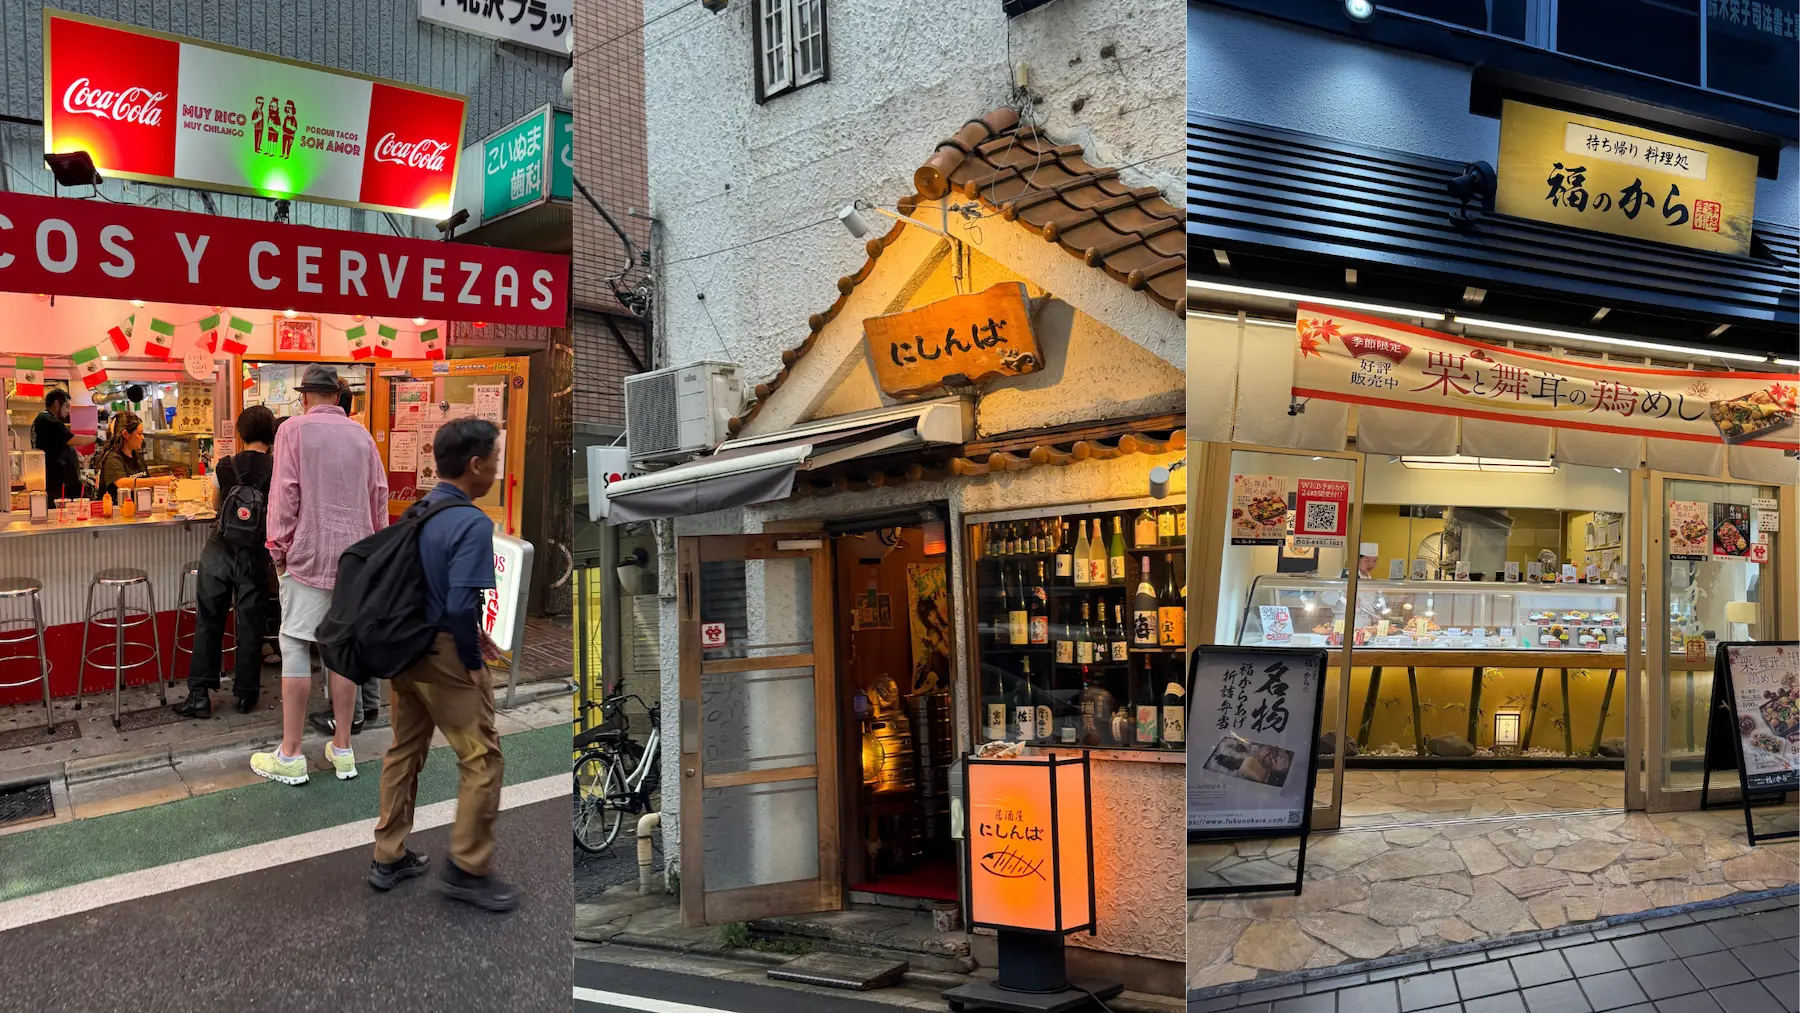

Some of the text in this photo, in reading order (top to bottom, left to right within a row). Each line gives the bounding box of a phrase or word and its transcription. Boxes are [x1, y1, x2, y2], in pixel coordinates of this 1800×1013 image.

[63, 77, 169, 126] Coca-Cola
[182, 104, 247, 126] MUY RICO
[183, 120, 244, 137] MUY CHILANGO
[300, 136, 361, 156] SON AMOR
[305, 125, 358, 141] PORQUE TACOS
[374, 132, 451, 172] Coca-Cola
[487, 125, 541, 175] こいぬま
[1586, 134, 1689, 170] 持ち帰り 料理処
[511, 160, 540, 200] 歯科
[1546, 162, 1689, 226] 福のから
[174, 232, 210, 284] Y
[248, 241, 554, 311] CERVEZAS
[891, 317, 1008, 367] にしんば
[1351, 335, 1402, 353] 季節限定
[1350, 372, 1399, 390] 販売中
[1360, 359, 1392, 375] 好評
[1409, 348, 1706, 421] 栗と舞茸の鶏めし
[1216, 669, 1238, 730] 折詰弁当
[1233, 662, 1254, 729] 福からあげ
[1251, 660, 1289, 734] 名物
[980, 823, 1044, 841] にしんば
[995, 809, 1024, 822] 居酒屋
